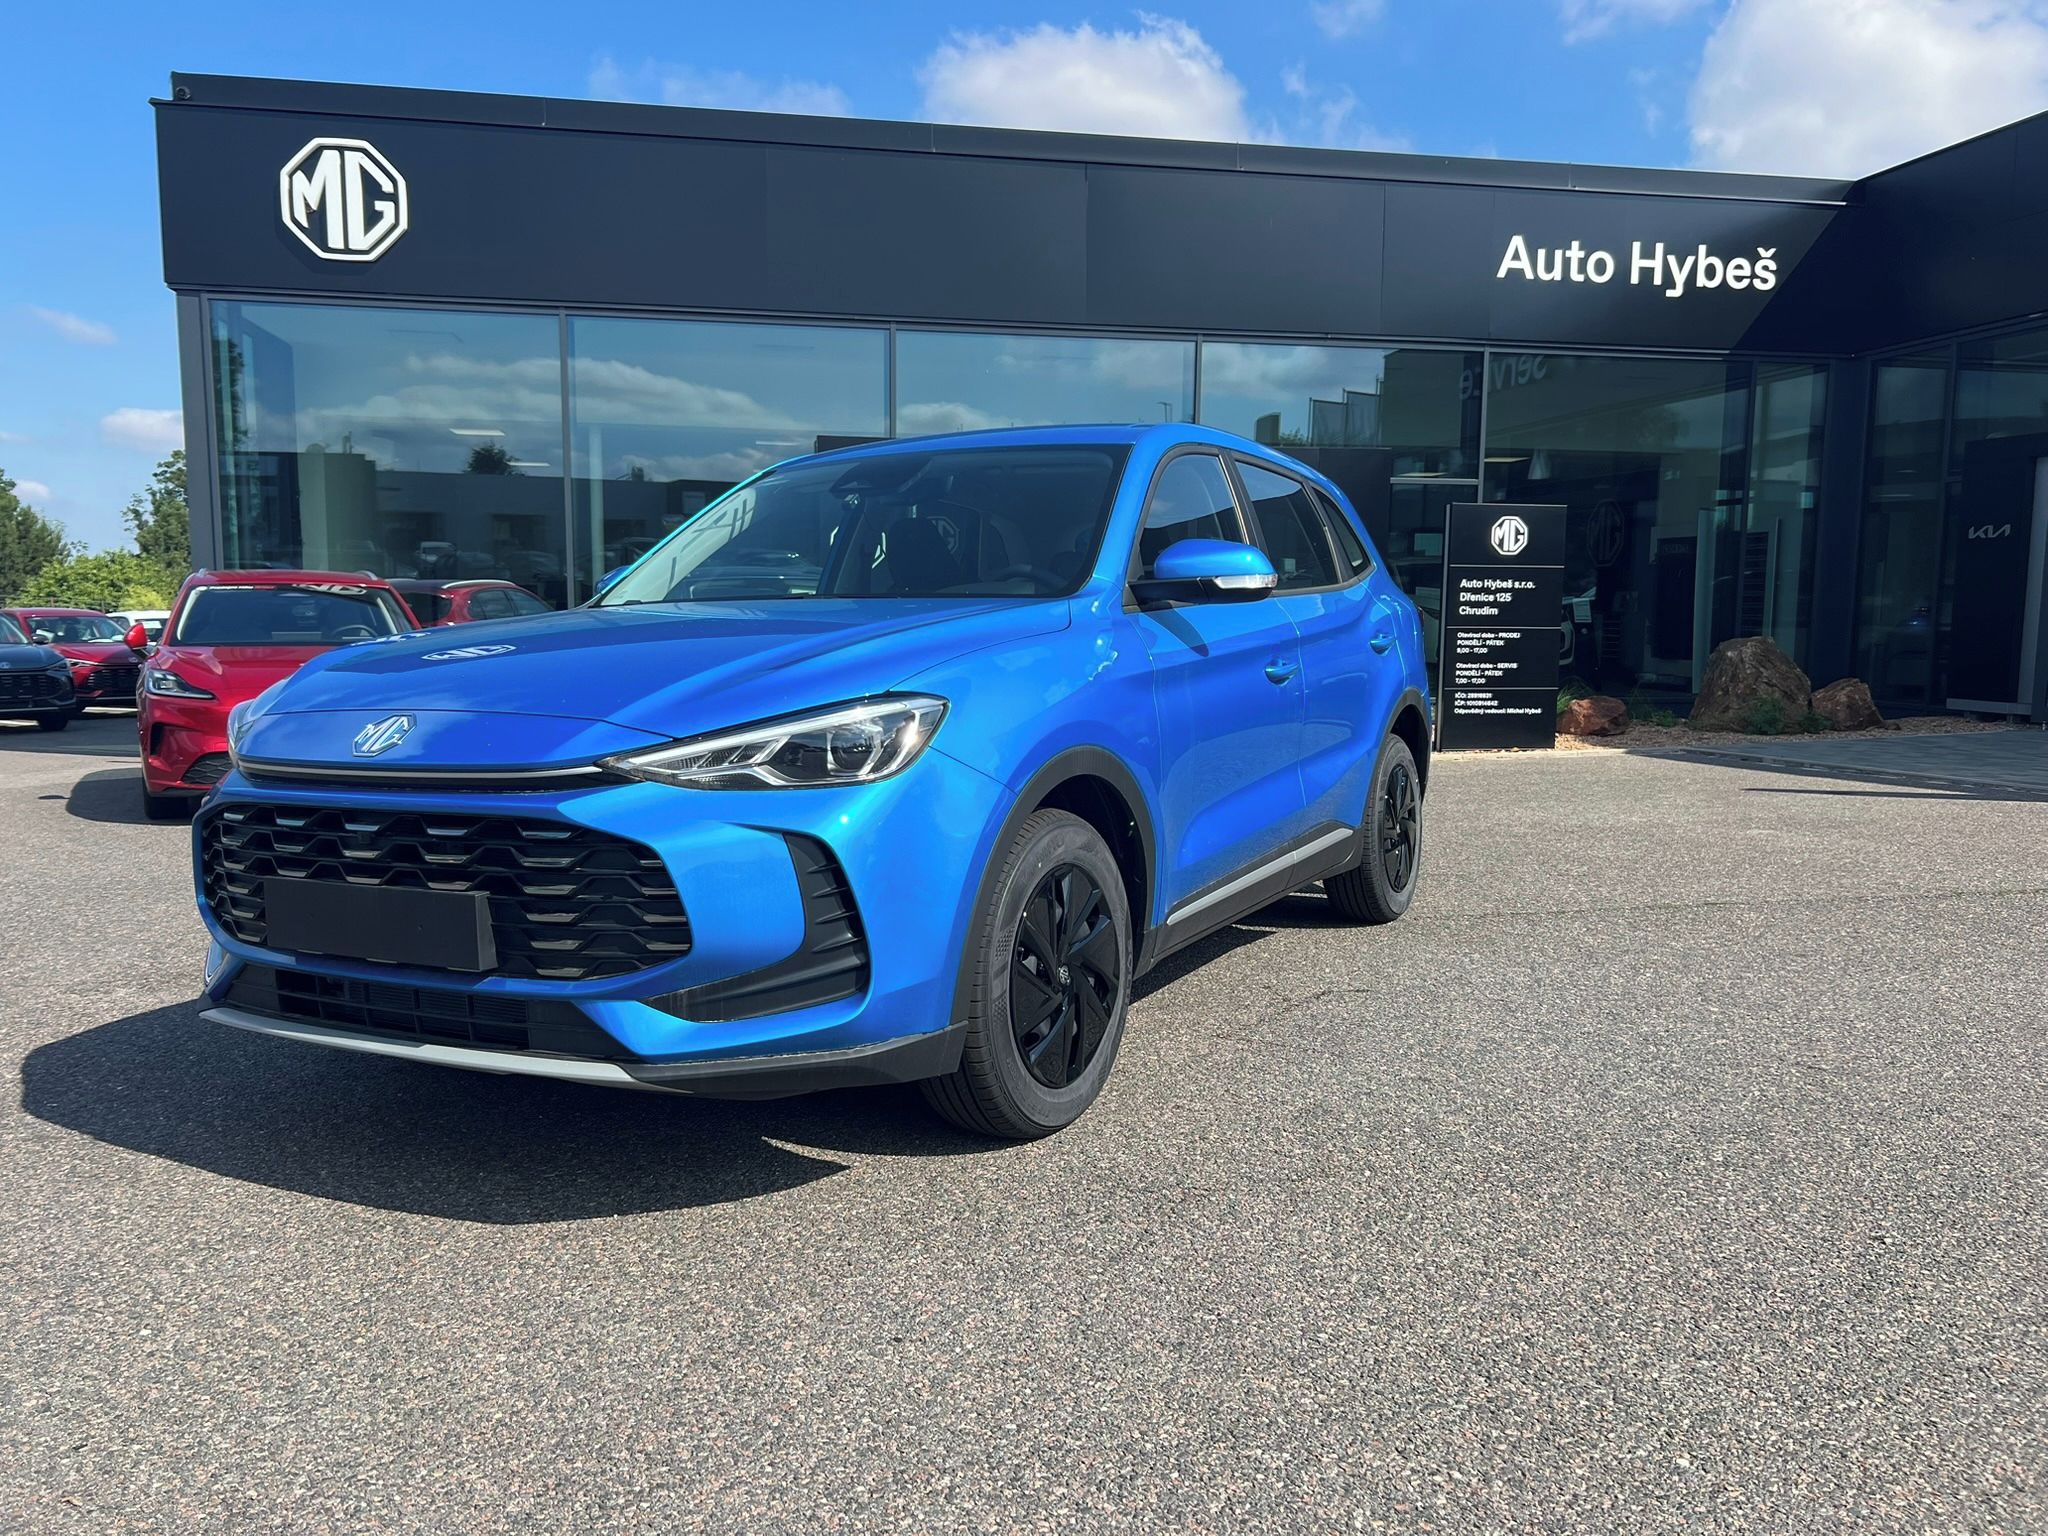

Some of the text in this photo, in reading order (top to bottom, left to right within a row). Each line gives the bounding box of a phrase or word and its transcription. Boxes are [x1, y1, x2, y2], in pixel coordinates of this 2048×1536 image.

[291, 149, 397, 251] MG
[1496, 234, 1778, 298] Auto Hybeš
[1494, 519, 1525, 552] MG
[1459, 578, 1536, 591] Auto Hybeš s.r.o.
[1459, 592, 1512, 602] Dřenice 125
[1458, 605, 1498, 615] Chrudim
[355, 715, 413, 754] MG
